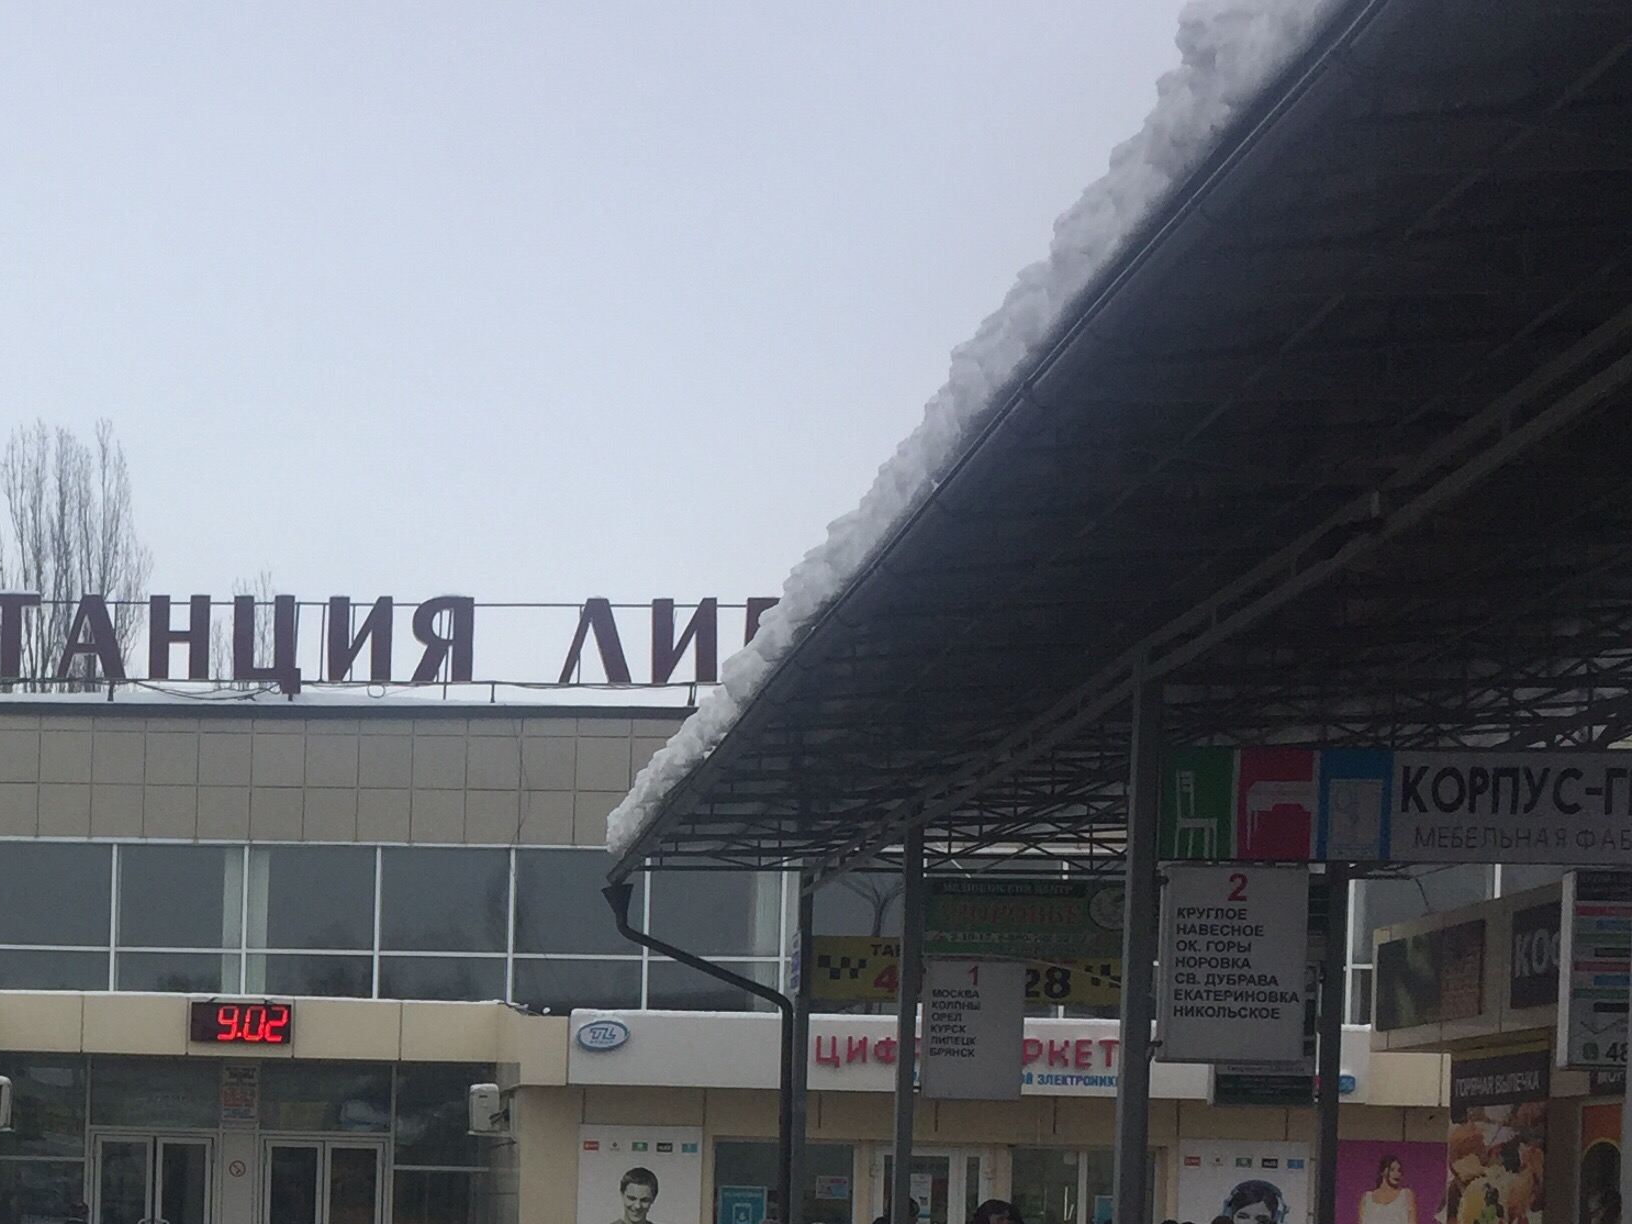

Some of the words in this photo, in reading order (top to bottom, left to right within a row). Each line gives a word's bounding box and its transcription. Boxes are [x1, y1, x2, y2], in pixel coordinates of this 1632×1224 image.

[1400, 765, 1632, 816] КОРПУС-Г
[1414, 826, 1569, 850] МЕБЕЛЬНАЯ
[1228, 873, 1248, 902] 2
[1177, 907, 1248, 920] КРУГЛОЕ
[1176, 923, 1264, 937] НАВЕСНОЕ
[1176, 940, 1201, 952] ОК.
[1206, 940, 1252, 953] ГОРЫ
[1175, 956, 1252, 969] НОРОВКА
[969, 966, 979, 985] 1
[1174, 972, 1201, 985] СВ.
[1204, 974, 1279, 987] ДУБРАВА
[932, 989, 980, 999] МОСКВА
[1173, 988, 1300, 1004] ЕКАТЕРИНОВКА
[931, 1001, 981, 1011] КОЛПНЫ
[1173, 1005, 1281, 1020] НИКОЛЬСКОЕ
[931, 1012, 963, 1022] ОРЕЛ
[930, 1024, 967, 1034] КУРСК
[930, 1036, 977, 1046] ЛИПЕЦК
[929, 1048, 976, 1058] БРЯНСК
[1037, 1073, 1118, 1087] ЭЛЕКТРОНИК
